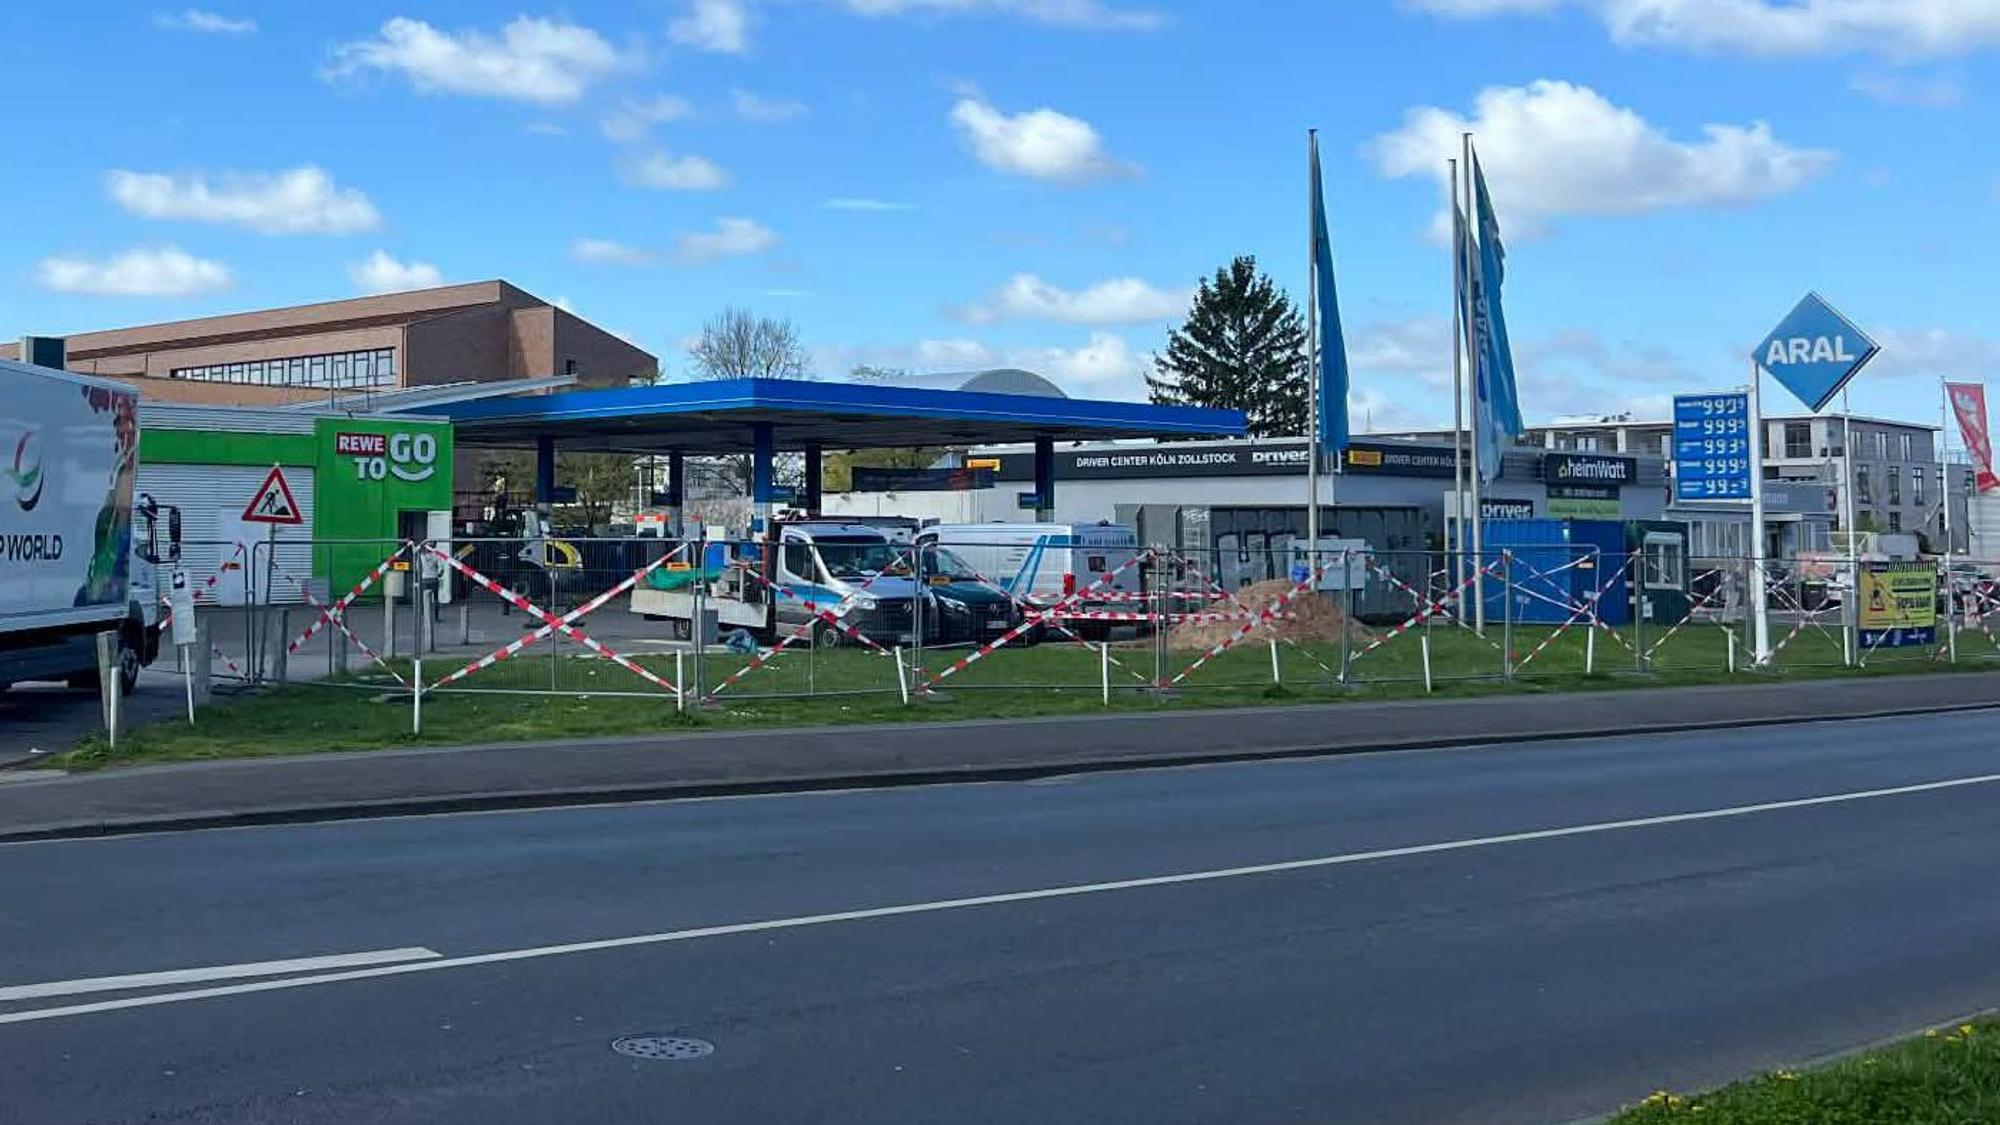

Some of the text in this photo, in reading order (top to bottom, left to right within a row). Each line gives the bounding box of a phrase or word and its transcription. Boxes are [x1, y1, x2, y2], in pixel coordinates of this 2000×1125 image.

[1766, 335, 1854, 365] ARAL
[338, 435, 385, 452] REWE
[390, 433, 436, 463] GO
[354, 457, 386, 480] TO
[1076, 452, 1236, 468] DRIVER CENTER KÖLN ZOLLSTOCK
[1567, 457, 1626, 479] heimWatt
[7, 534, 63, 561] WORLD
